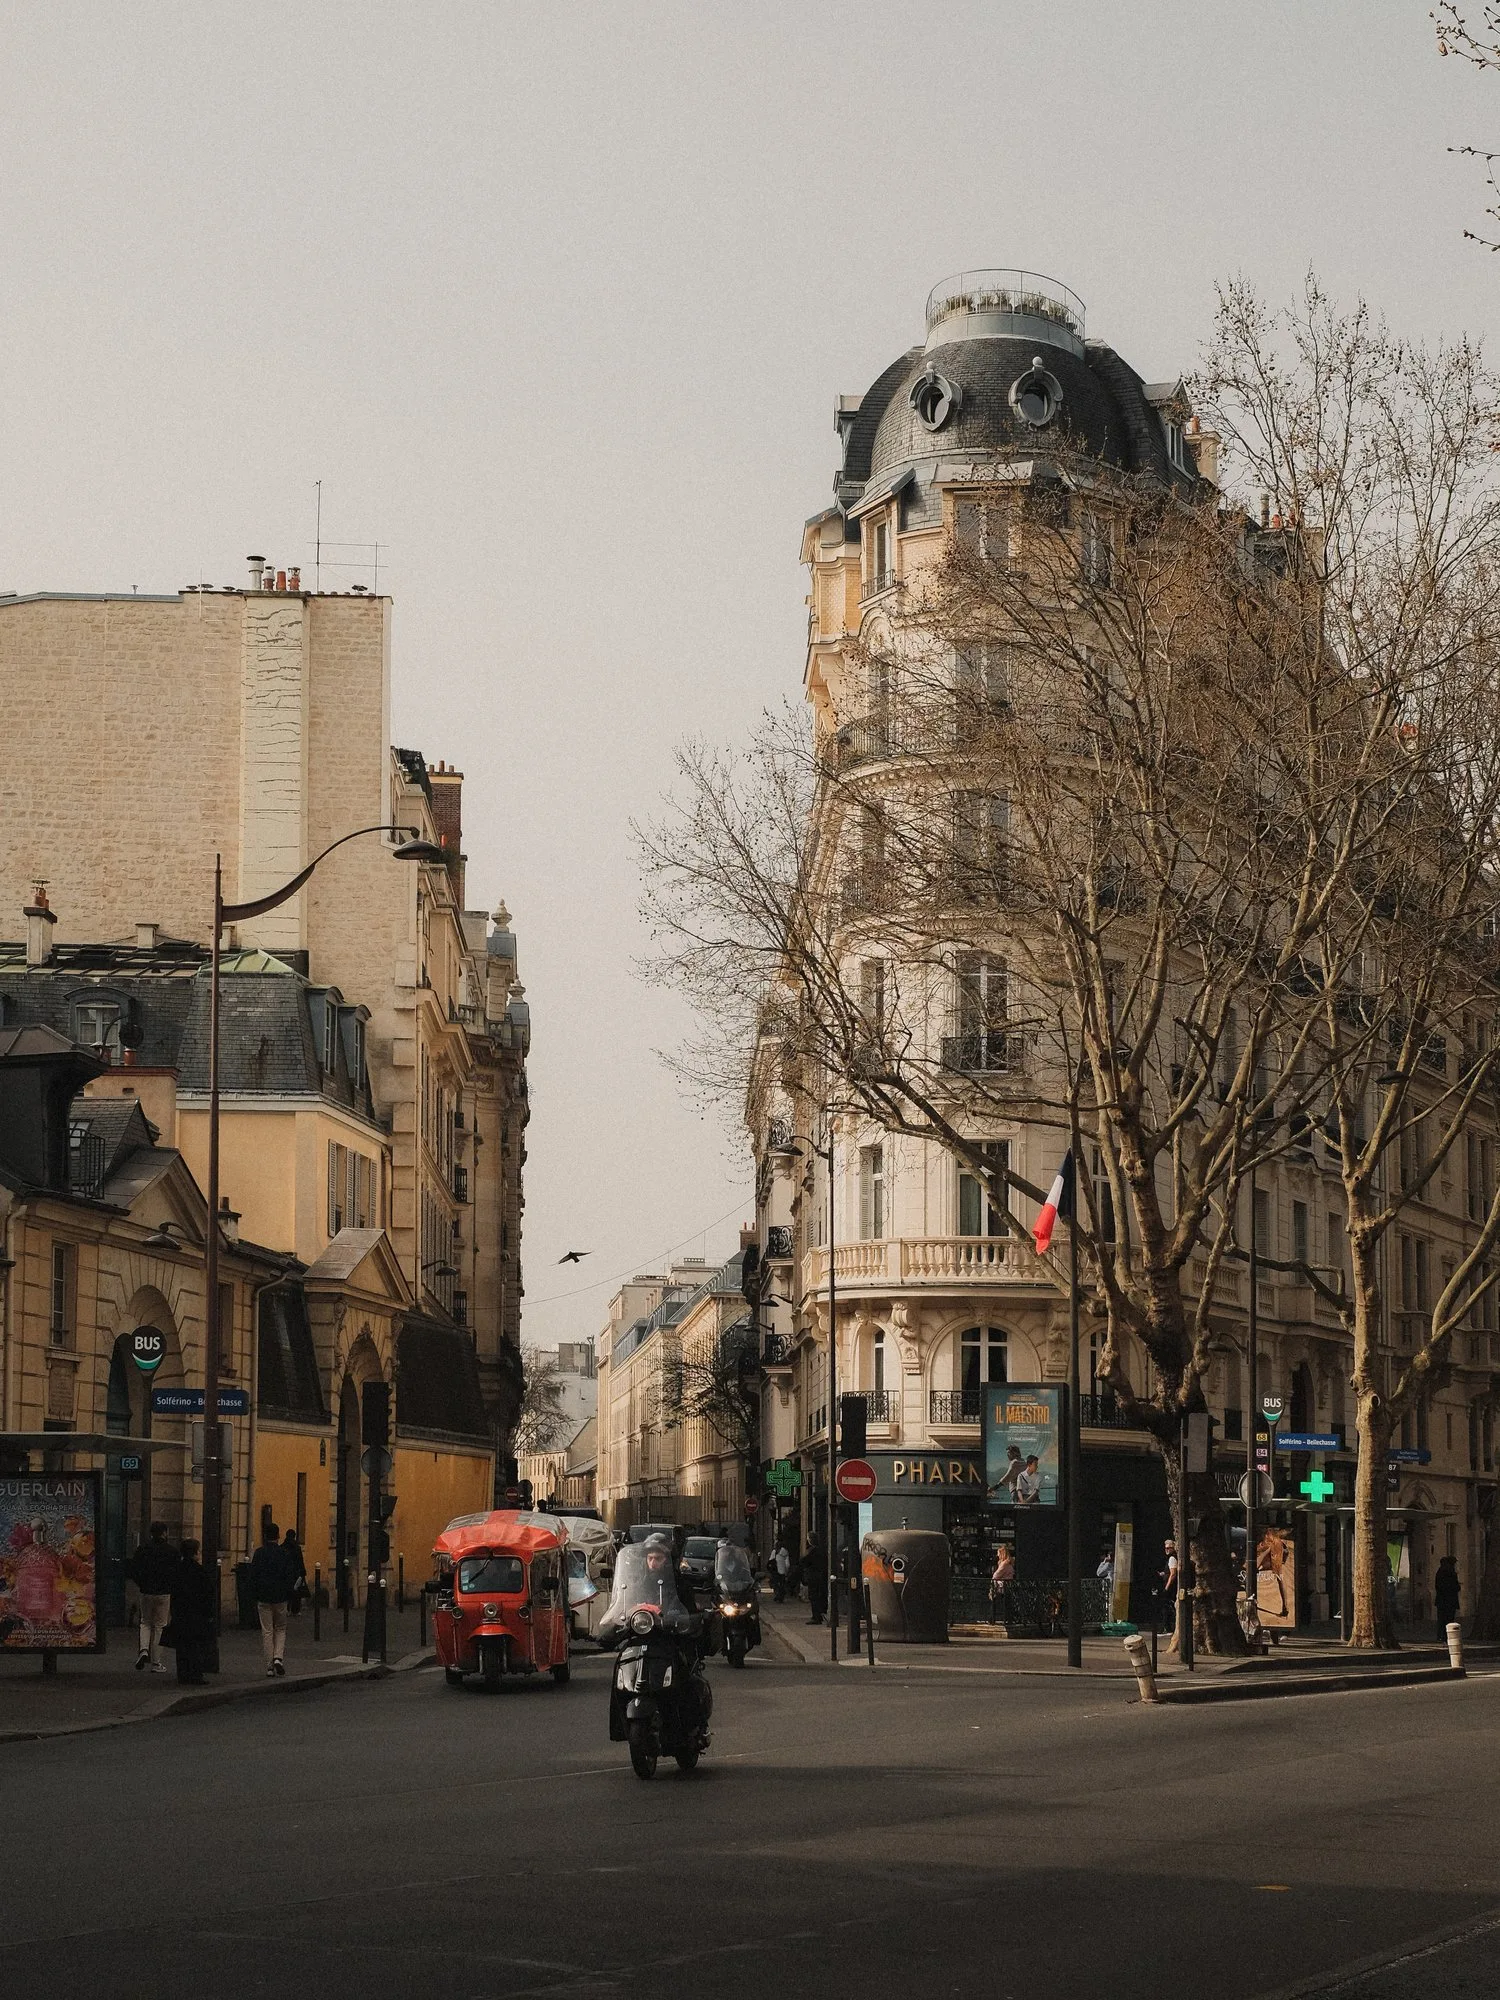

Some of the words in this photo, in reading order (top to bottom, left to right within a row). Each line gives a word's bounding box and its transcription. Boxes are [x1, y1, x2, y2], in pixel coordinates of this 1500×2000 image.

[134, 1336, 161, 1350] BUS
[156, 1396, 192, 1406] Solférino
[198, 1397, 242, 1406] Bechasse
[1263, 1397, 1282, 1408] BUS
[995, 1405, 1004, 1424] IL
[1006, 1405, 1050, 1424] MAESTRO
[123, 1458, 137, 1468] 69
